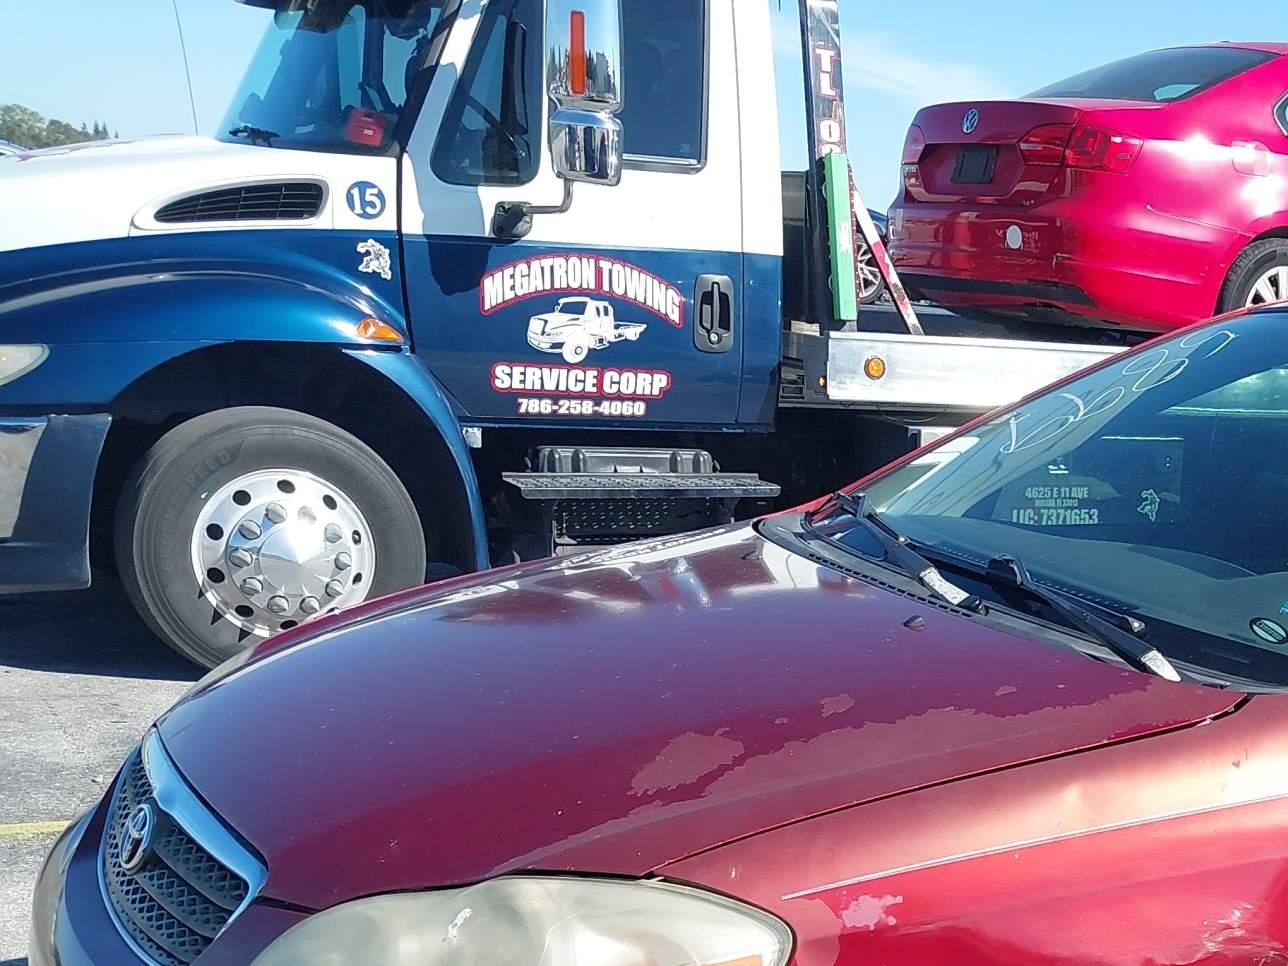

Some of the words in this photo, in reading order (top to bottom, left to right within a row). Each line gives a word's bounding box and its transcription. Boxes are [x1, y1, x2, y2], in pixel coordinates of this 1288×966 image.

[350, 186, 382, 215] 15
[482, 256, 596, 311] MEGATRON
[599, 258, 681, 325] TOWING
[494, 364, 598, 394] SERVICE
[602, 371, 669, 397] CORP
[517, 398, 646, 416] 786-258-4060
[1025, 487, 1052, 498] 4625
[1053, 487, 1059, 498] E
[1070, 487, 1089, 499] AVE
[1040, 508, 1099, 526] 7371653
